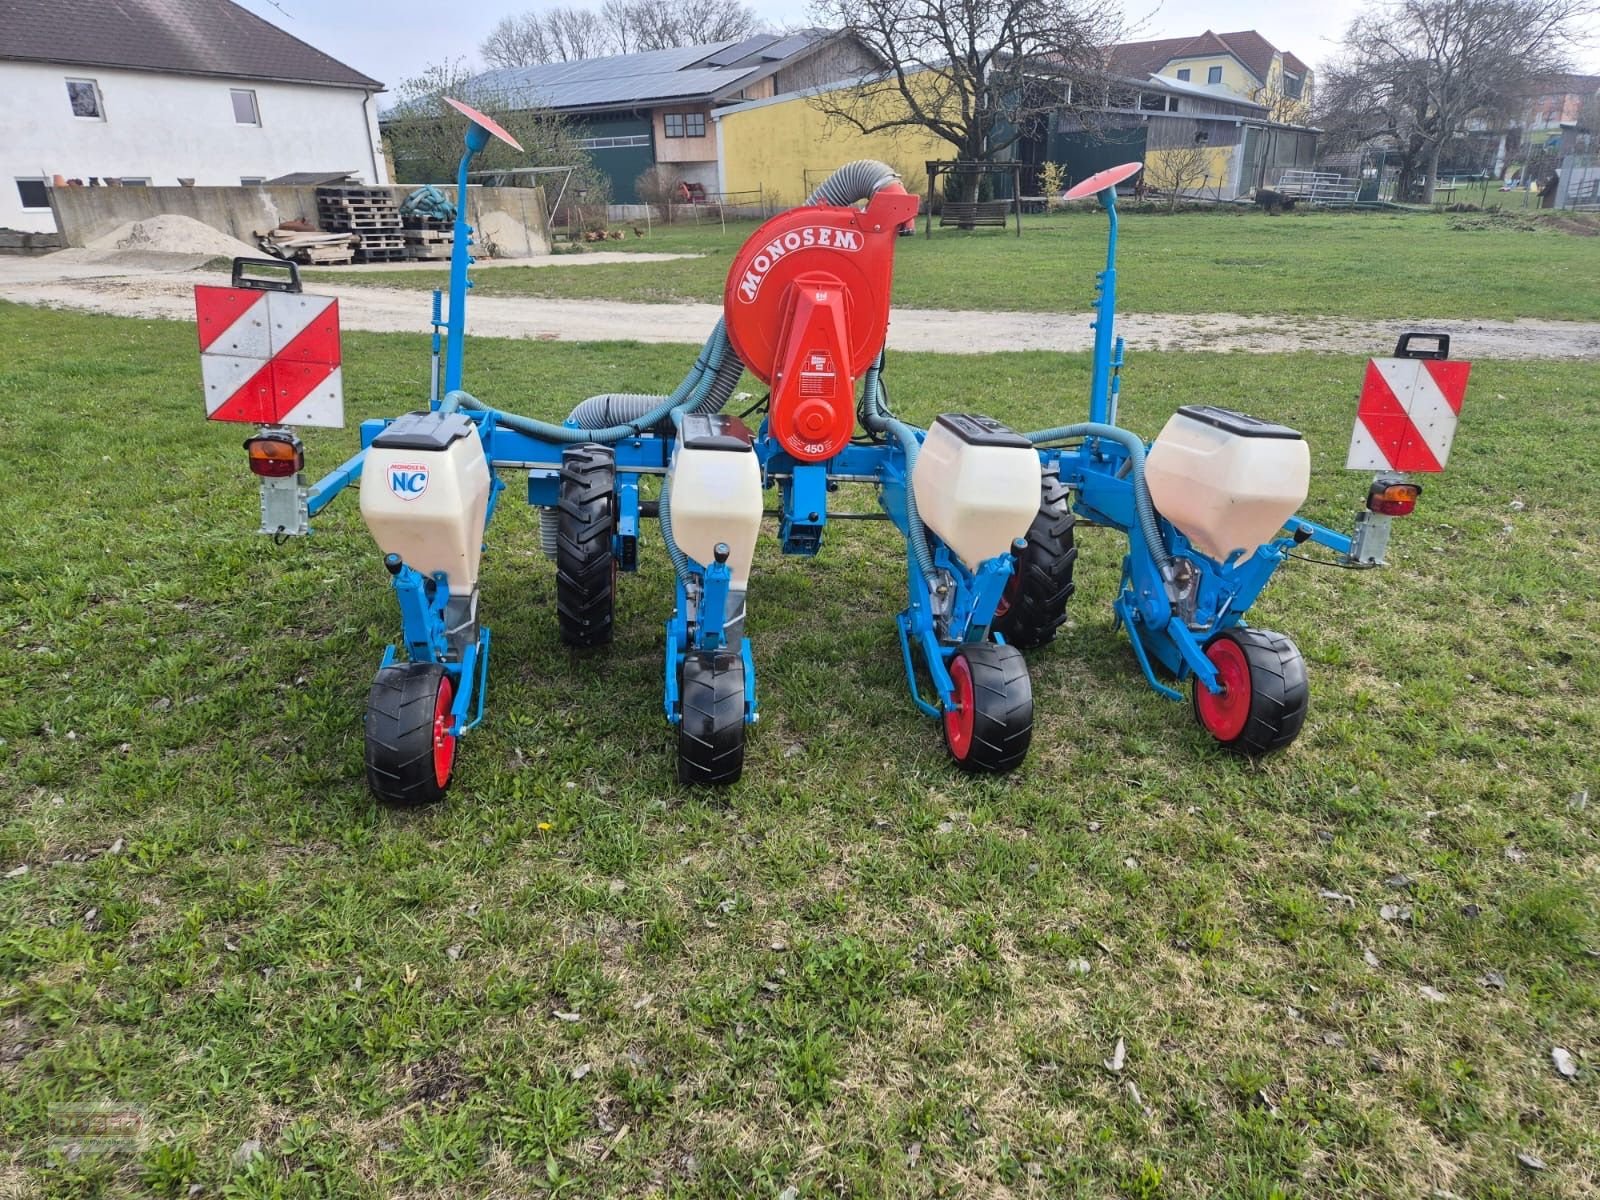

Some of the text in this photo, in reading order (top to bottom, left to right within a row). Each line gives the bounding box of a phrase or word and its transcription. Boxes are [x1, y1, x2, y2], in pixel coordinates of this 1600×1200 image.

[741, 228, 857, 300] MONOSEM
[804, 444, 824, 453] 450
[392, 472, 426, 492] NC
